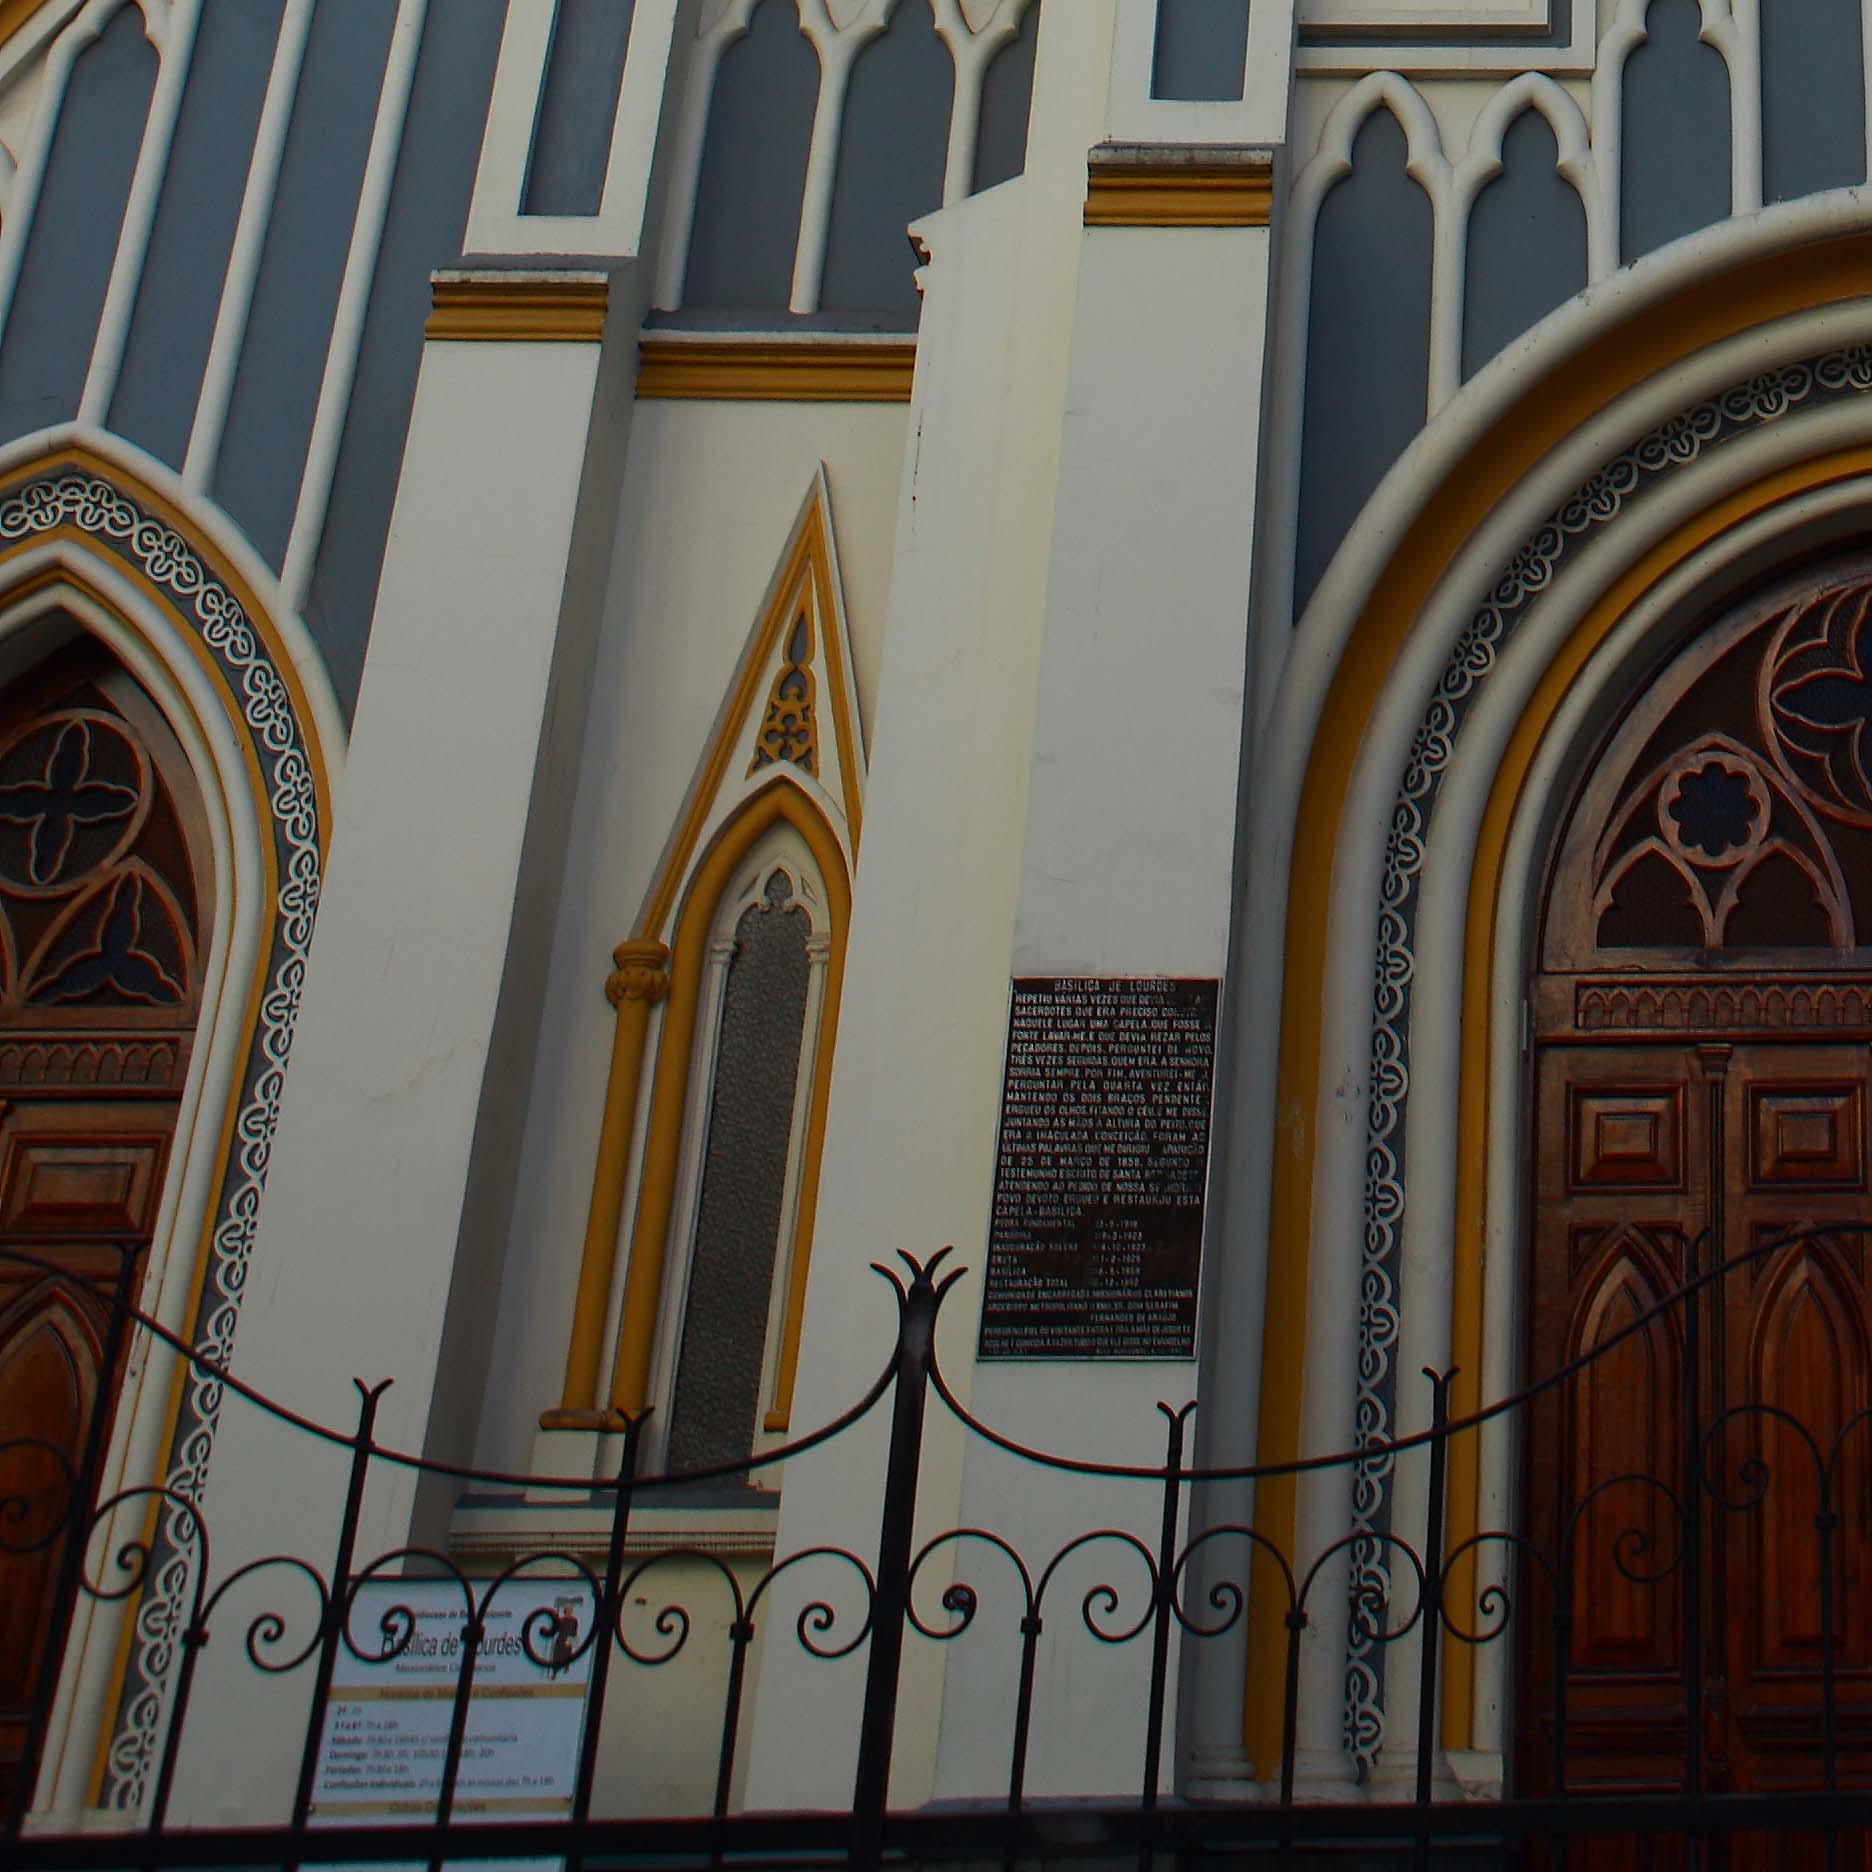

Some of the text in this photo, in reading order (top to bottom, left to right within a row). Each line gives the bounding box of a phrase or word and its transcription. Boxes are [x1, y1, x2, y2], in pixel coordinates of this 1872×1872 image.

[1070, 1080, 1096, 1091] PELA
[1103, 1081, 1143, 1091] QUARTA
[440, 1631, 458, 1656] de
[474, 1631, 522, 1656] ourdes
